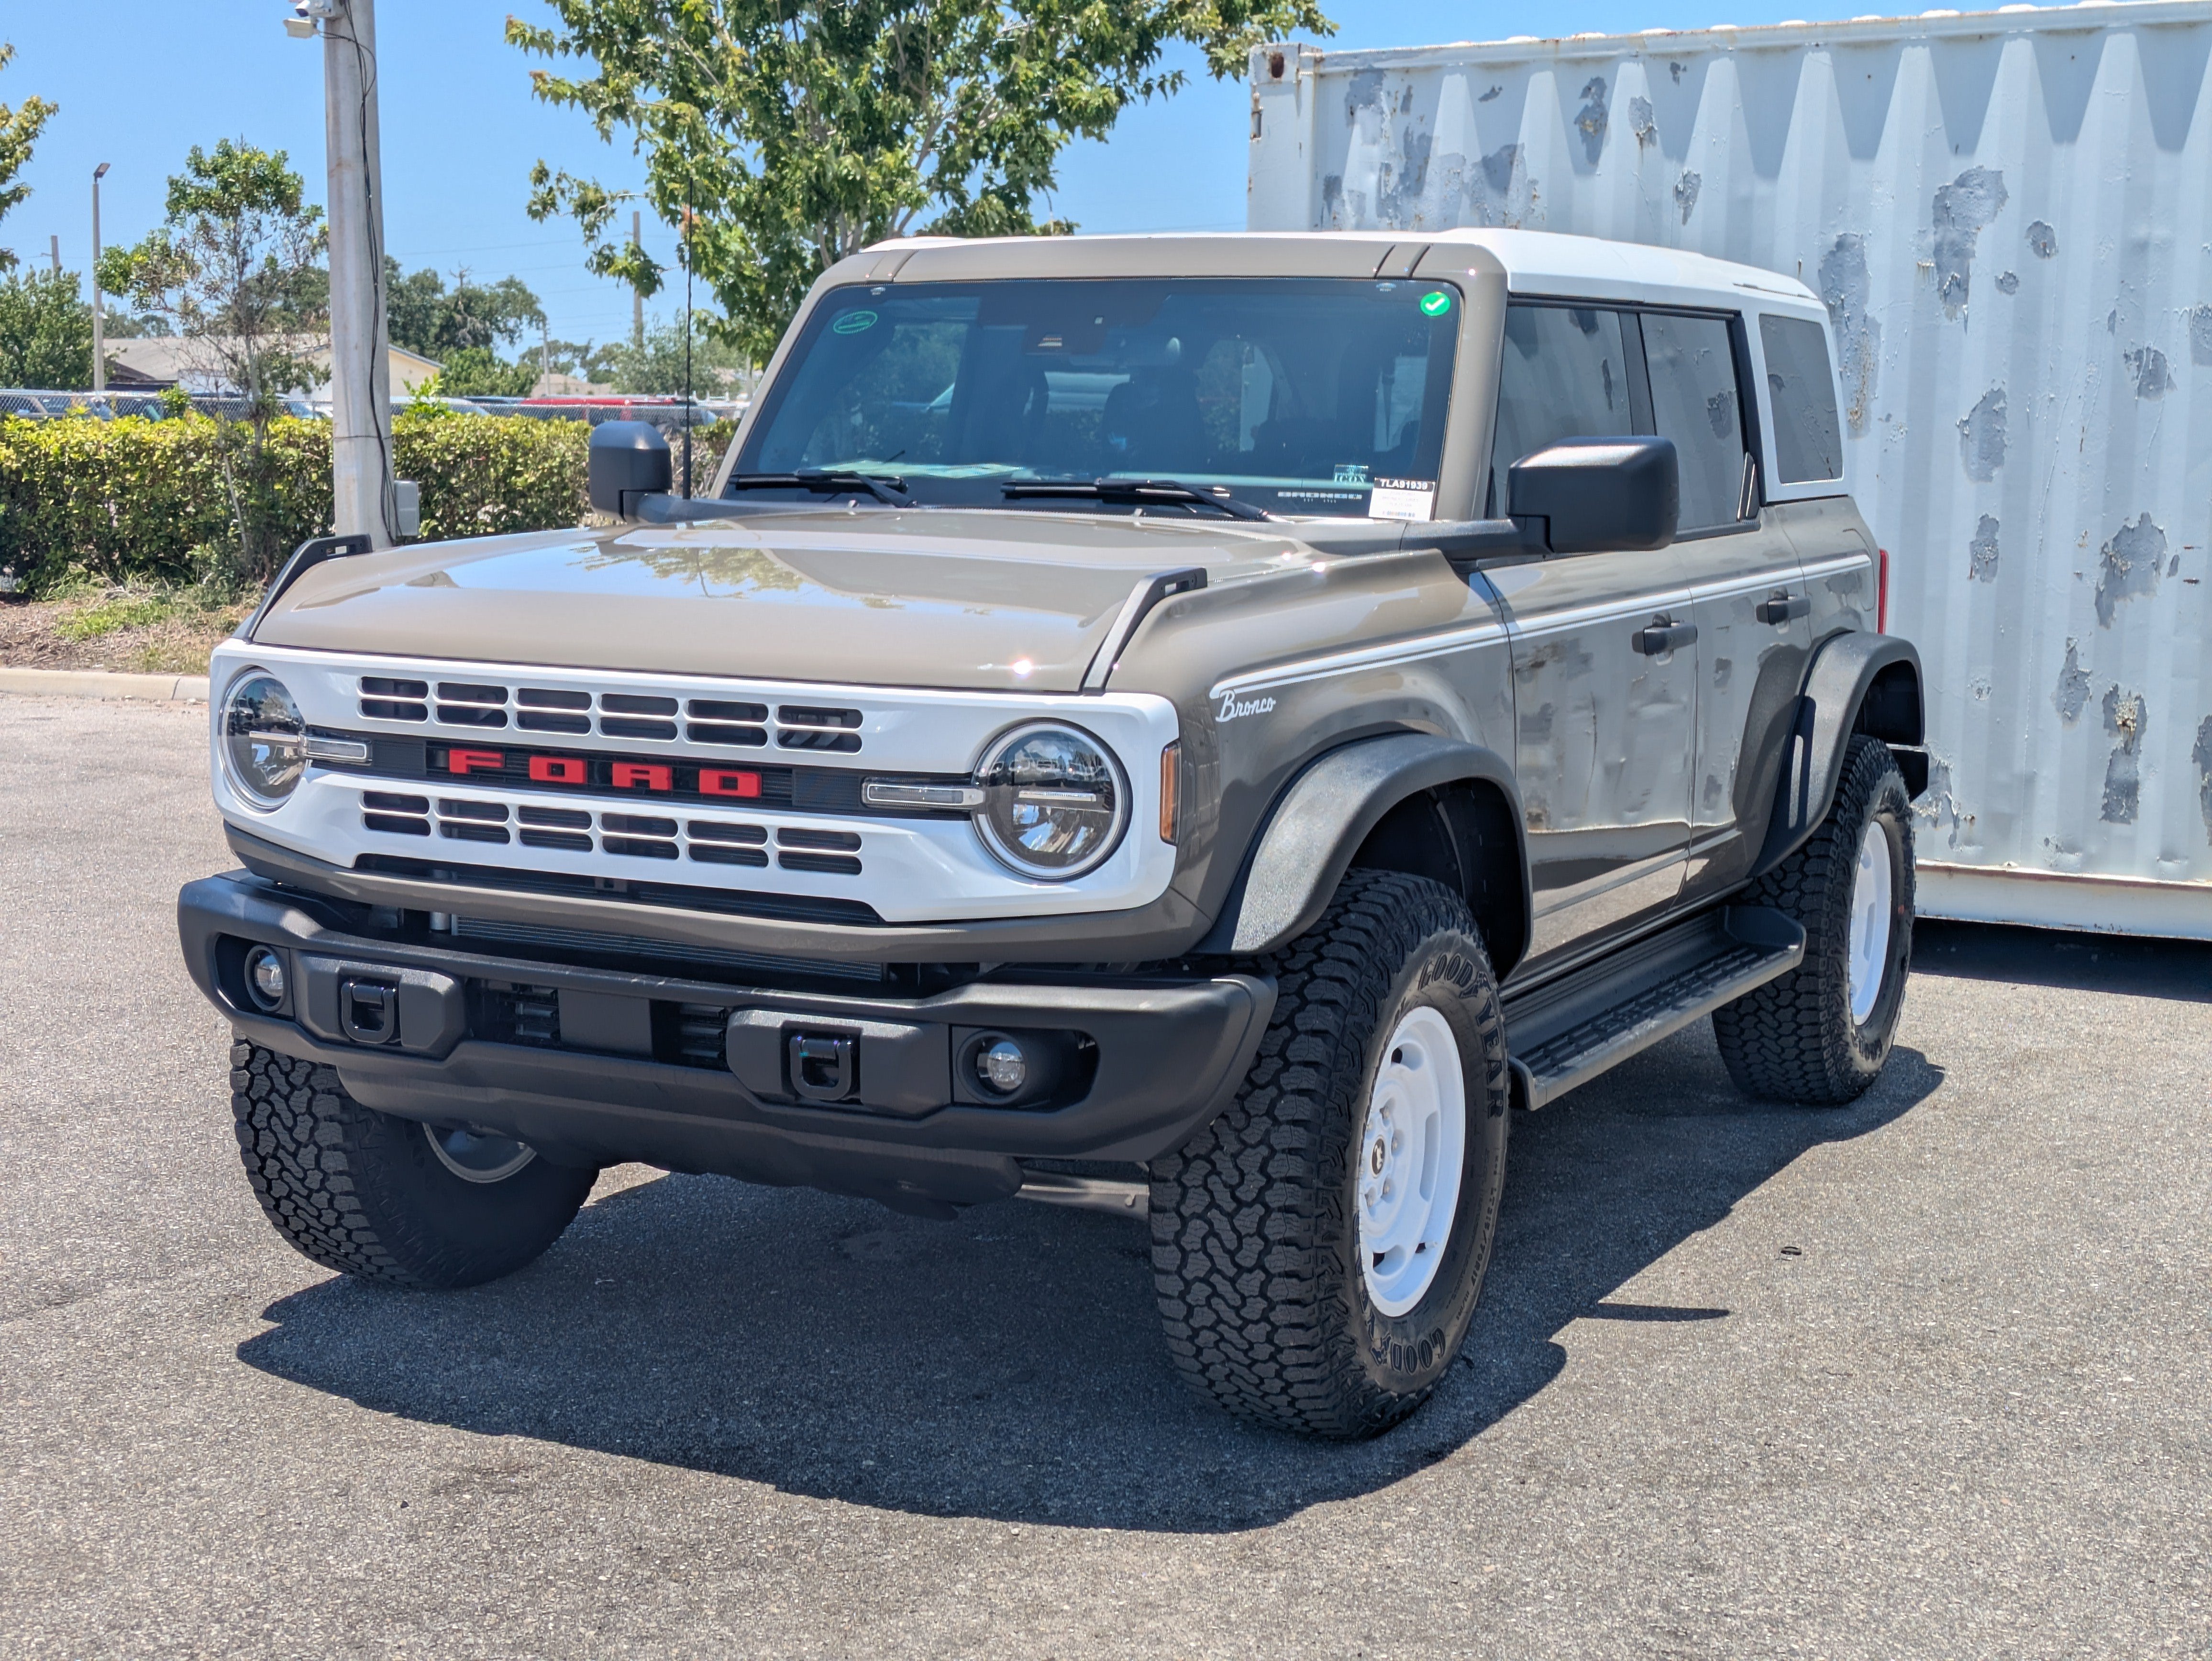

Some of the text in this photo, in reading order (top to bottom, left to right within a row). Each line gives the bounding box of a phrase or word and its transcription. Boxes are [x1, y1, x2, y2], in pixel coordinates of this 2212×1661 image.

[1215, 690, 1276, 722] Bronco
[448, 749, 763, 798] FORD
[1418, 952, 1504, 1119] GOODYEAR
